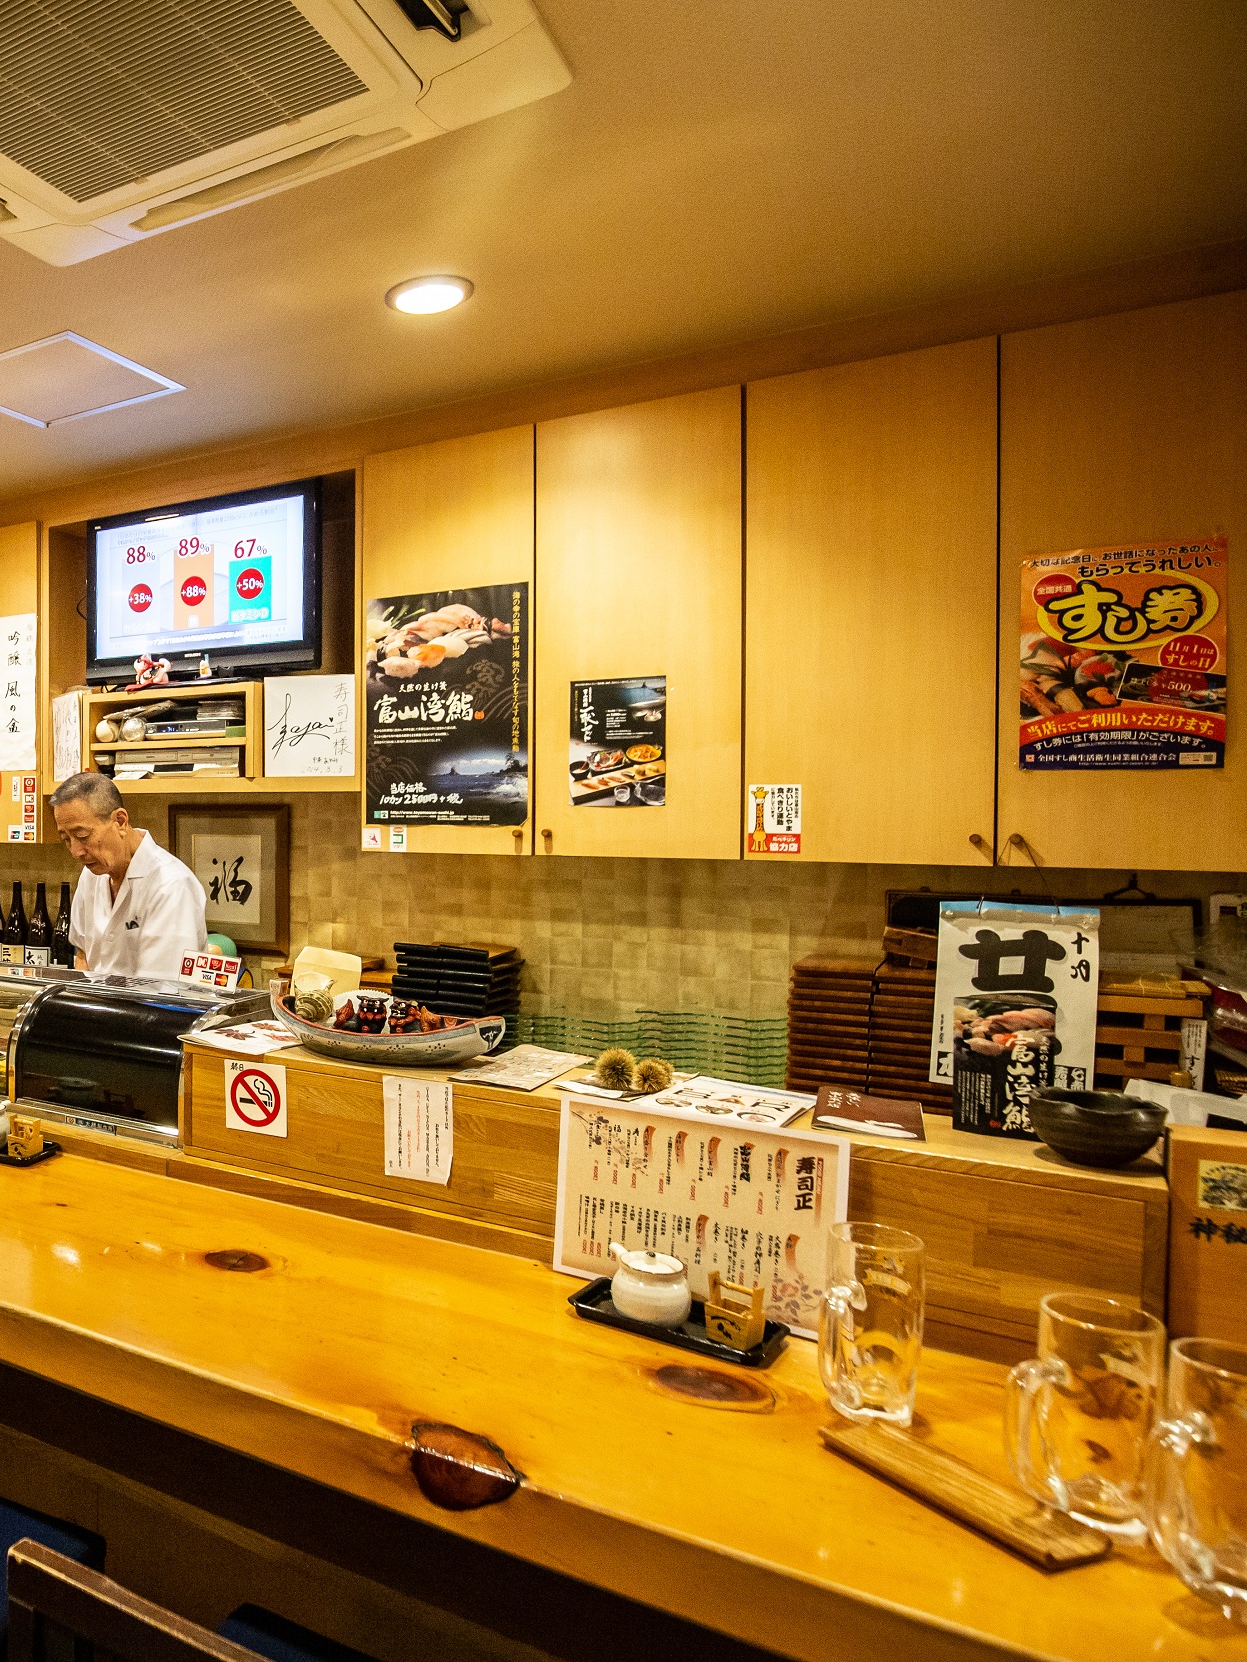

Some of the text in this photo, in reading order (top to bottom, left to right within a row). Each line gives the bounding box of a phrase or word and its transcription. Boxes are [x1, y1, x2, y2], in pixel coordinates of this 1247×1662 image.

[126, 545, 156, 565] 88%
[178, 536, 210, 557] 89%
[234, 538, 267, 559] 67%
[1077, 555, 1222, 579] もらってうれしい。
[1036, 585, 1072, 596] 全国共通
[1046, 581, 1201, 643] すし券
[1165, 653, 1211, 669] すしの日
[374, 690, 474, 724] 富山湾鮨
[333, 682, 353, 755] 寿司正様
[1027, 712, 1215, 738] 当店にてご利用いただけます。
[1033, 730, 1206, 751] すし券には「有効期限」がございます。
[769, 842, 798, 852] 協力店
[209, 855, 253, 906] 福
[794, 1156, 816, 1211] 寿司正
